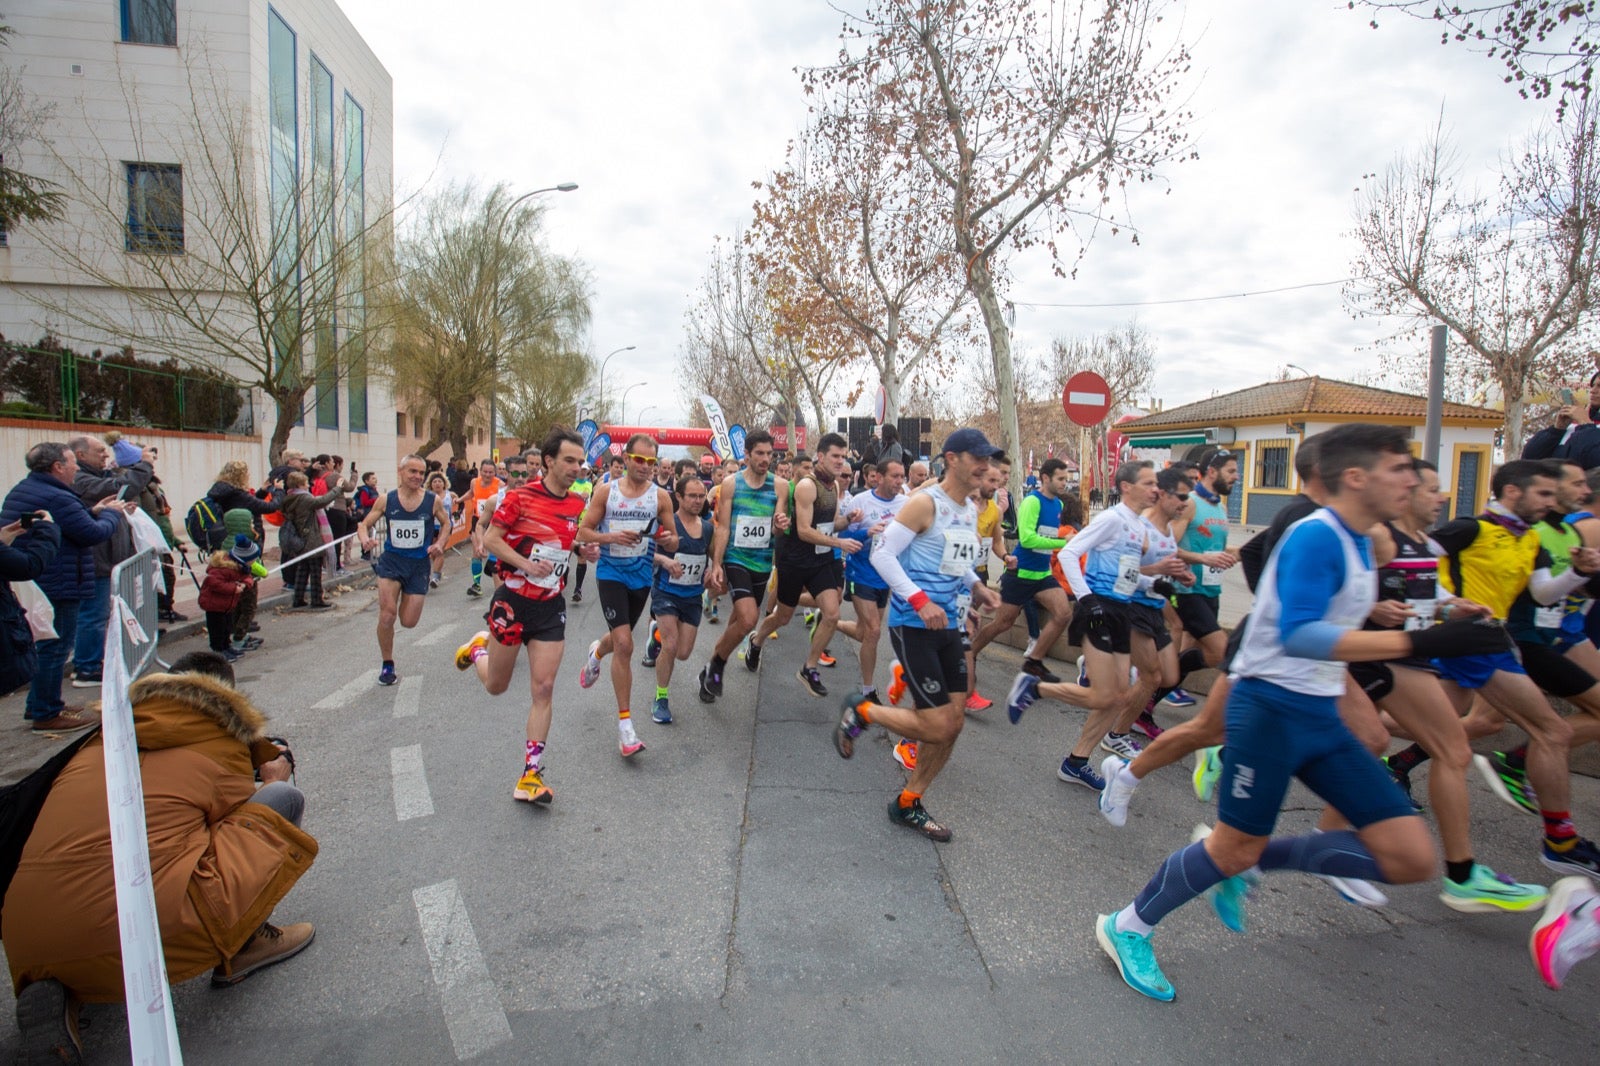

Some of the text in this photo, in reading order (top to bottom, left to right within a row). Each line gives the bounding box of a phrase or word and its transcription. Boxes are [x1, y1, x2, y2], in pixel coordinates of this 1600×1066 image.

[611, 510, 651, 519] MARACENA
[396, 528, 419, 539] 805
[742, 526, 765, 538] 340
[953, 543, 975, 560] 741
[680, 563, 701, 576] 212
[1232, 763, 1256, 799] FILA
